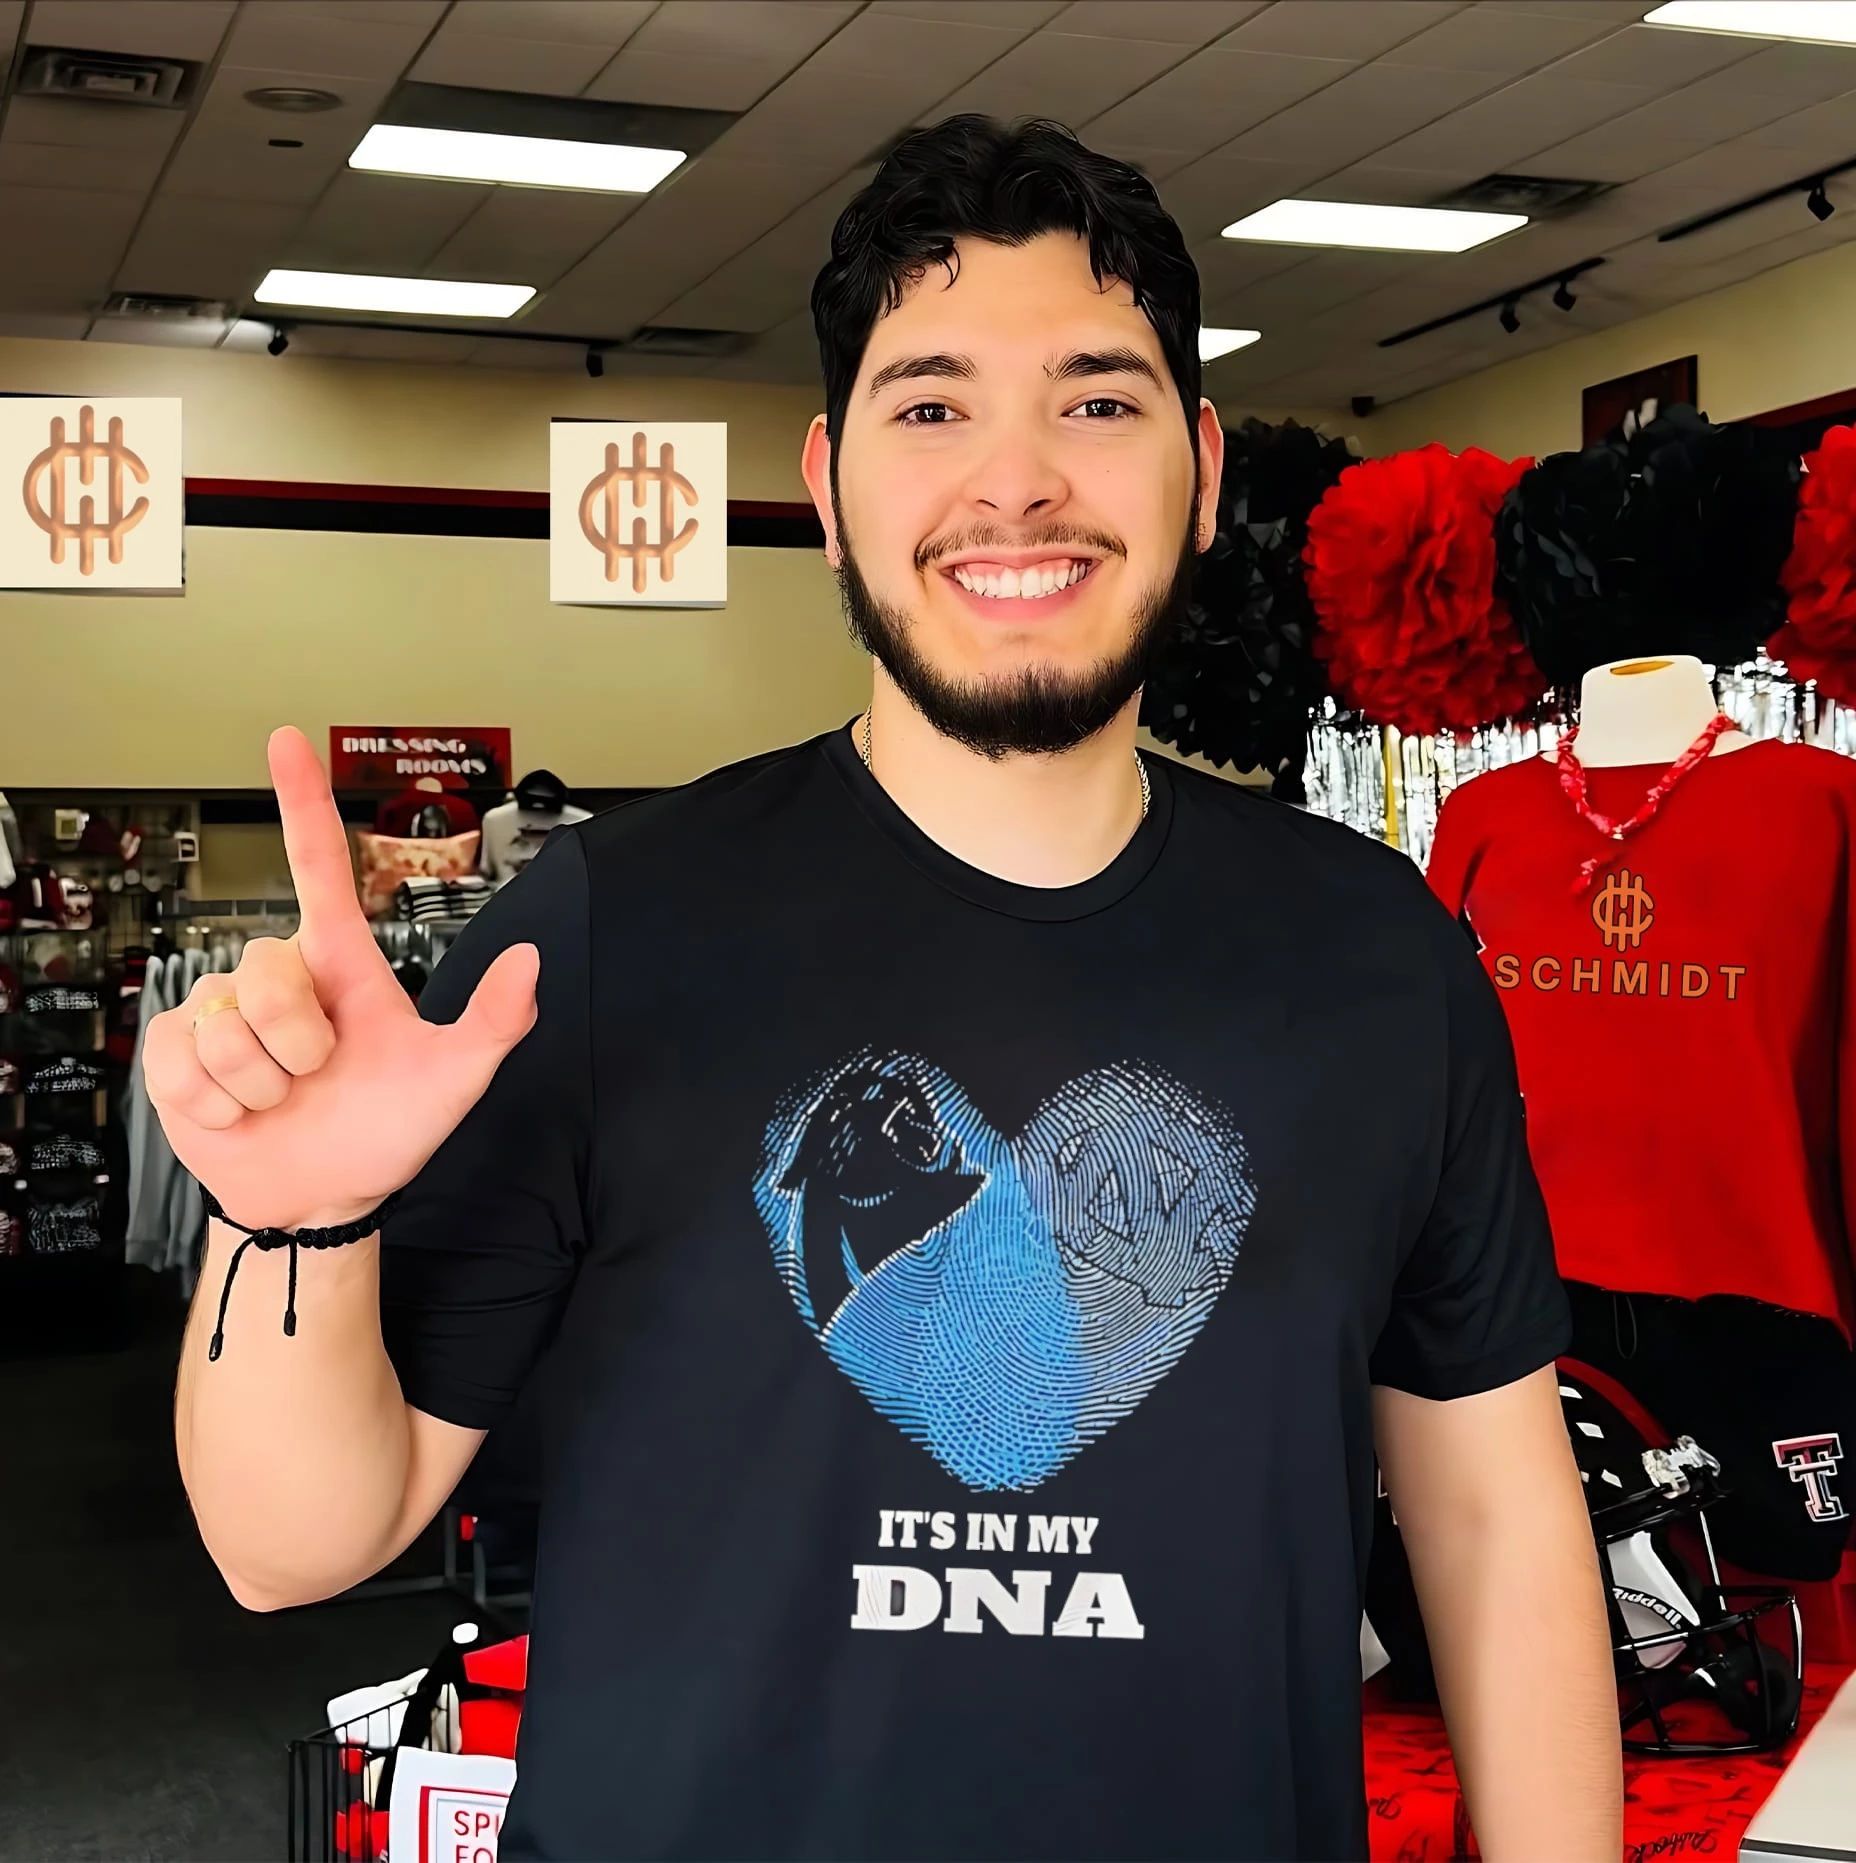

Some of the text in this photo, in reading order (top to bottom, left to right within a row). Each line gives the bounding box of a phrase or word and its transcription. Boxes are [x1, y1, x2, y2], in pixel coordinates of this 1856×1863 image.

[342, 737, 467, 754] DRESSING
[396, 758, 487, 775] ROOMS
[1494, 954, 1746, 1000] SCHMIDT
[878, 1509, 1099, 1554] IT'S IN MY
[850, 1564, 1145, 1639] DNA
